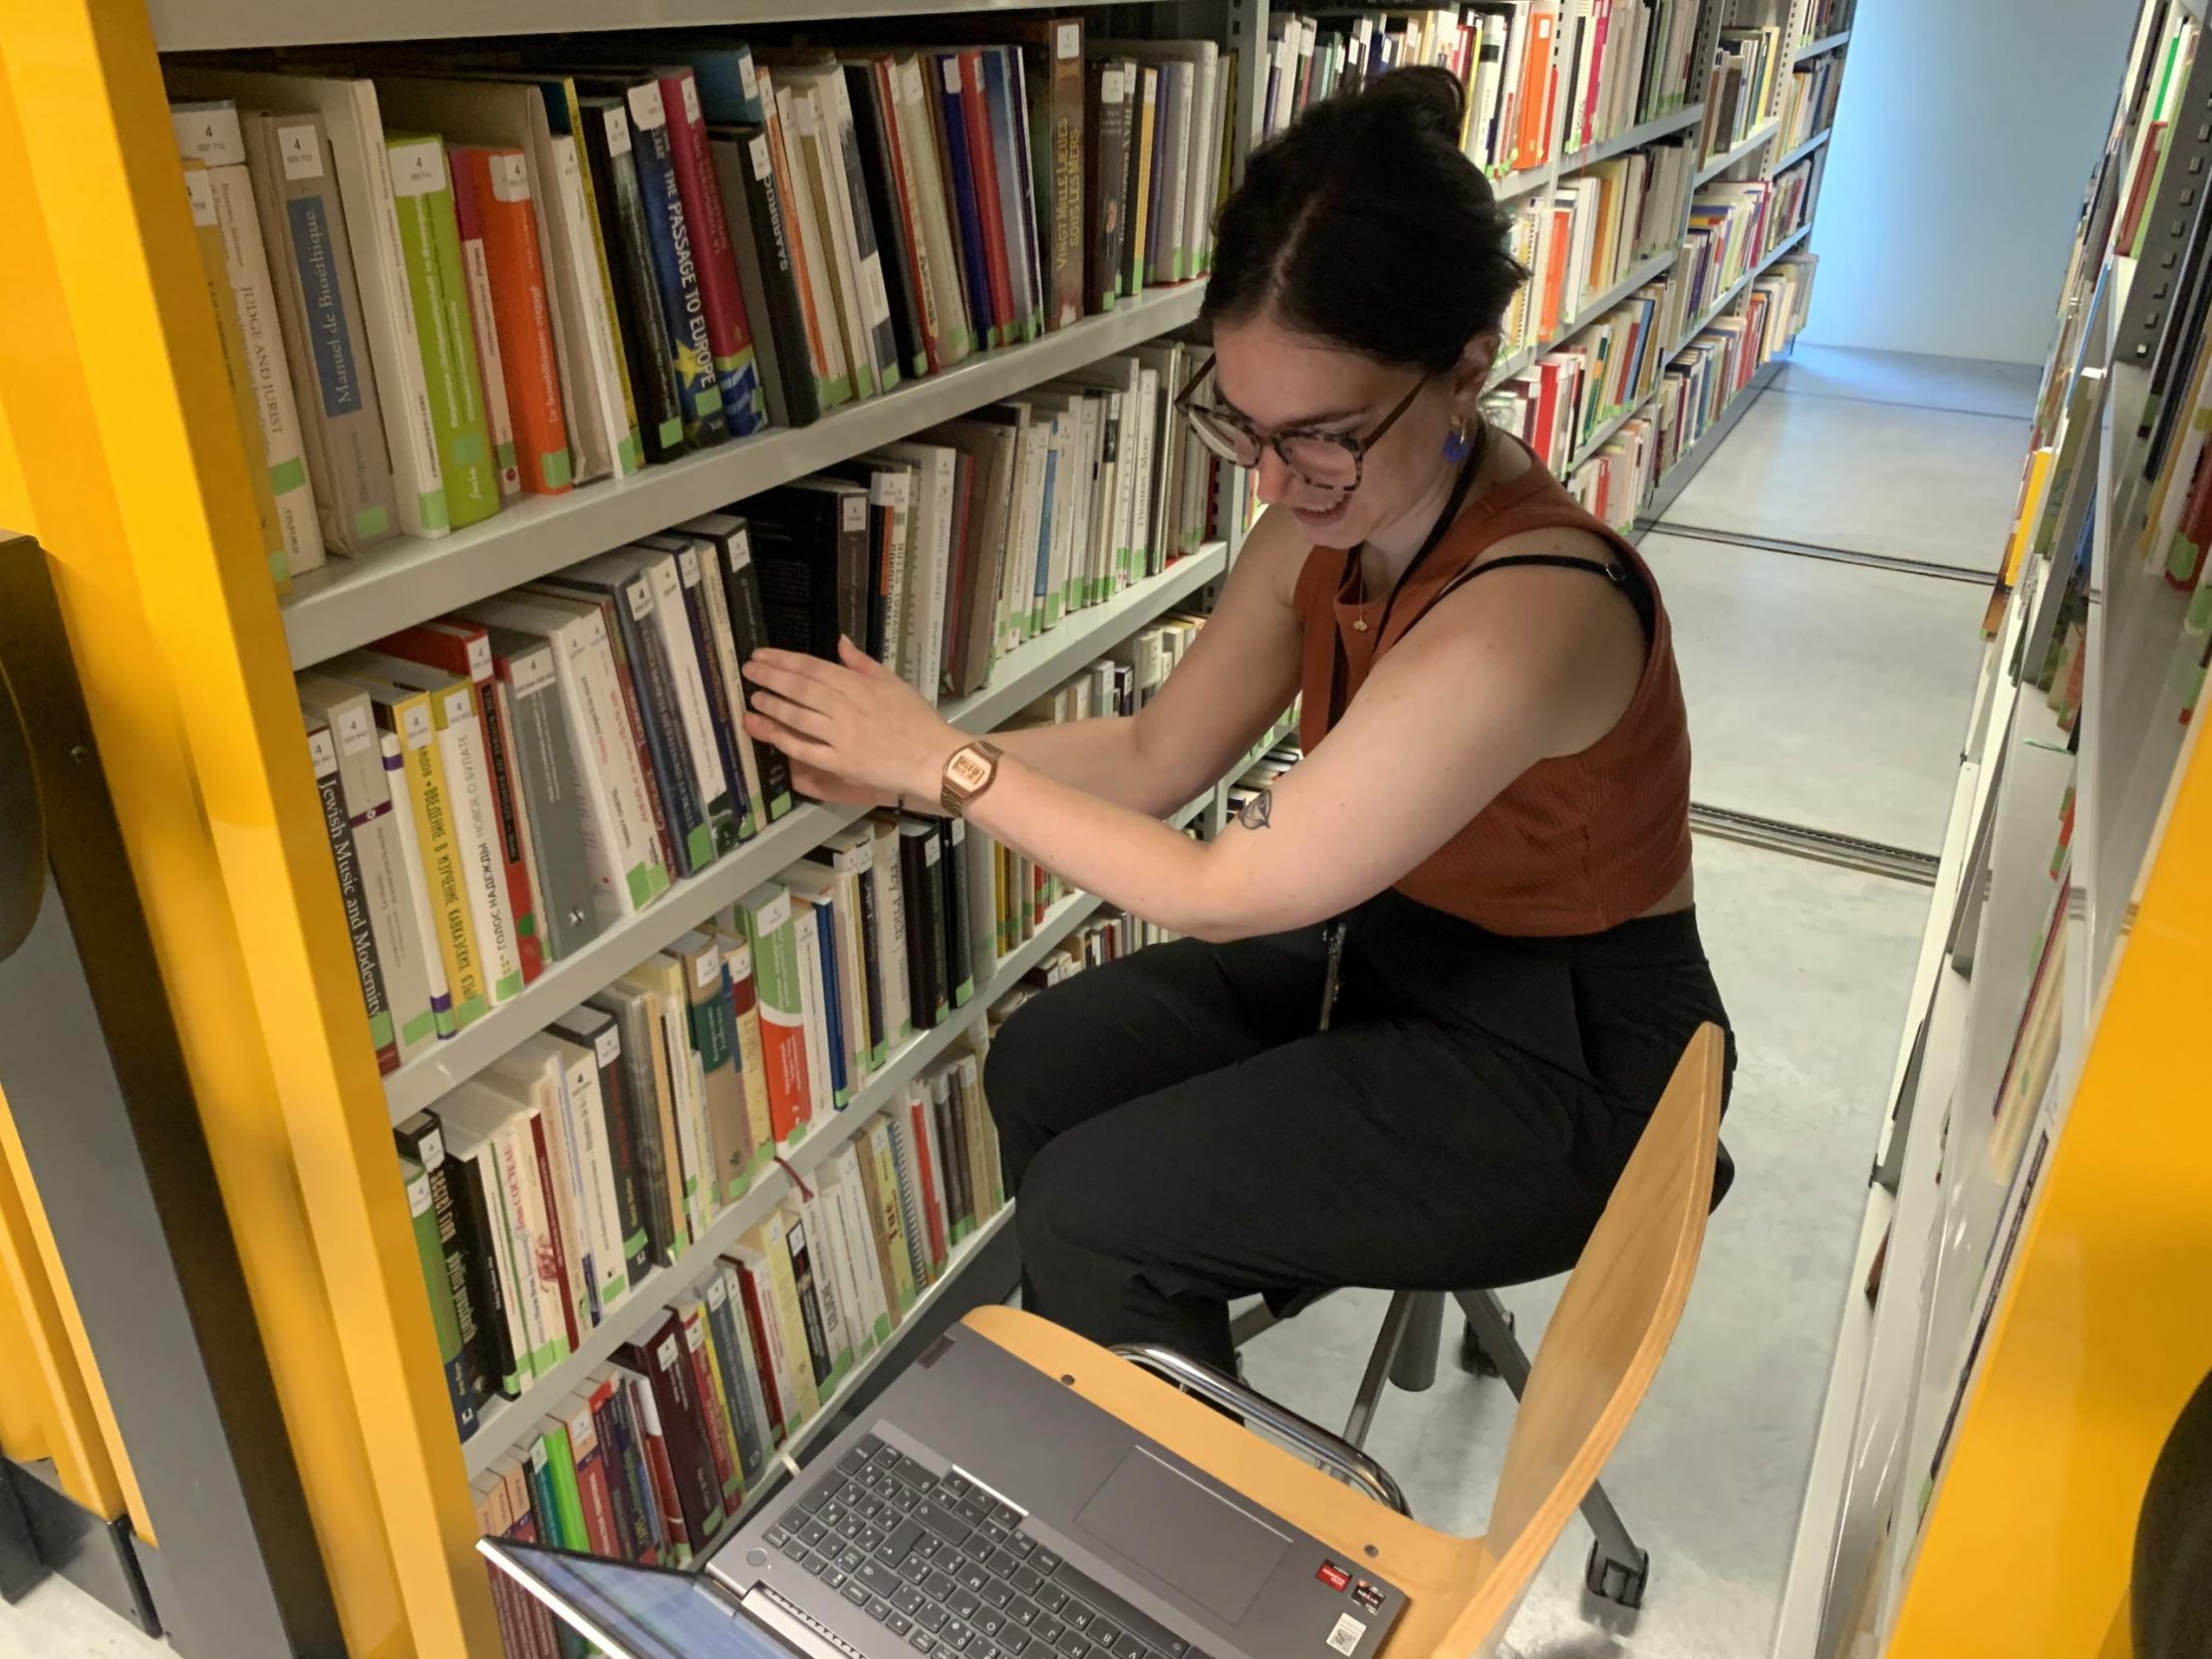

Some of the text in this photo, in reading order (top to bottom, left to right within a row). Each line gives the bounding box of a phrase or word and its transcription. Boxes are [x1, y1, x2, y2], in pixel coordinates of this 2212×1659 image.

[205, 127, 212, 137] 4
[294, 138, 301, 149] 4
[416, 157, 422, 167] 4
[515, 165, 520, 174] 4
[1070, 128, 1080, 247] SOUS LES MERS
[1055, 118, 1067, 270] VINGT MILLE LIEUES
[760, 174, 790, 271] SAARBRUC
[472, 247, 481, 276] Polen
[663, 167, 714, 388] THE PASSAGE TO EUROPE
[303, 207, 350, 404] Manuel de Bioéthique
[529, 284, 558, 422] Le bouddhisme engagé
[240, 285, 283, 435] JUDGE AND JURIST
[1135, 432, 1149, 526] Thomas More
[639, 589, 645, 599] 4
[478, 648, 483, 657] 4
[531, 661, 536, 670] 4
[482, 689, 494, 712] THE
[351, 720, 357, 729] 4
[316, 744, 322, 753] 4
[457, 734, 506, 950] ГОЛОС НАДЕЖДЫ НОВОЕ О БУЛАТЕ
[321, 778, 384, 1014] Jewish Music and Modernity
[424, 787, 477, 1001] ВВЕДЕНИЕ В ИЗУЧЕНИЕ КАВКАЗСКИХ ЯЗЫ
[892, 895, 904, 941] Pilch
[577, 1074, 583, 1083] 4
[500, 1145, 526, 1231] Jean COCTEAU
[866, 1506, 874, 1515] 5
[828, 1513, 837, 1521] 9
[885, 1519, 893, 1527] 4
[847, 1524, 855, 1533] 8
[969, 1576, 981, 1587] M
[997, 1594, 1005, 1604] L
[961, 1605, 970, 1614] P
[1020, 1611, 1030, 1621] K
[1075, 1614, 1086, 1625] N
[984, 1620, 996, 1631] O
[1047, 1628, 1056, 1638] J
[1102, 1633, 1112, 1643] B
[1071, 1646, 1082, 1656] H
[1128, 1650, 1138, 1659] V
